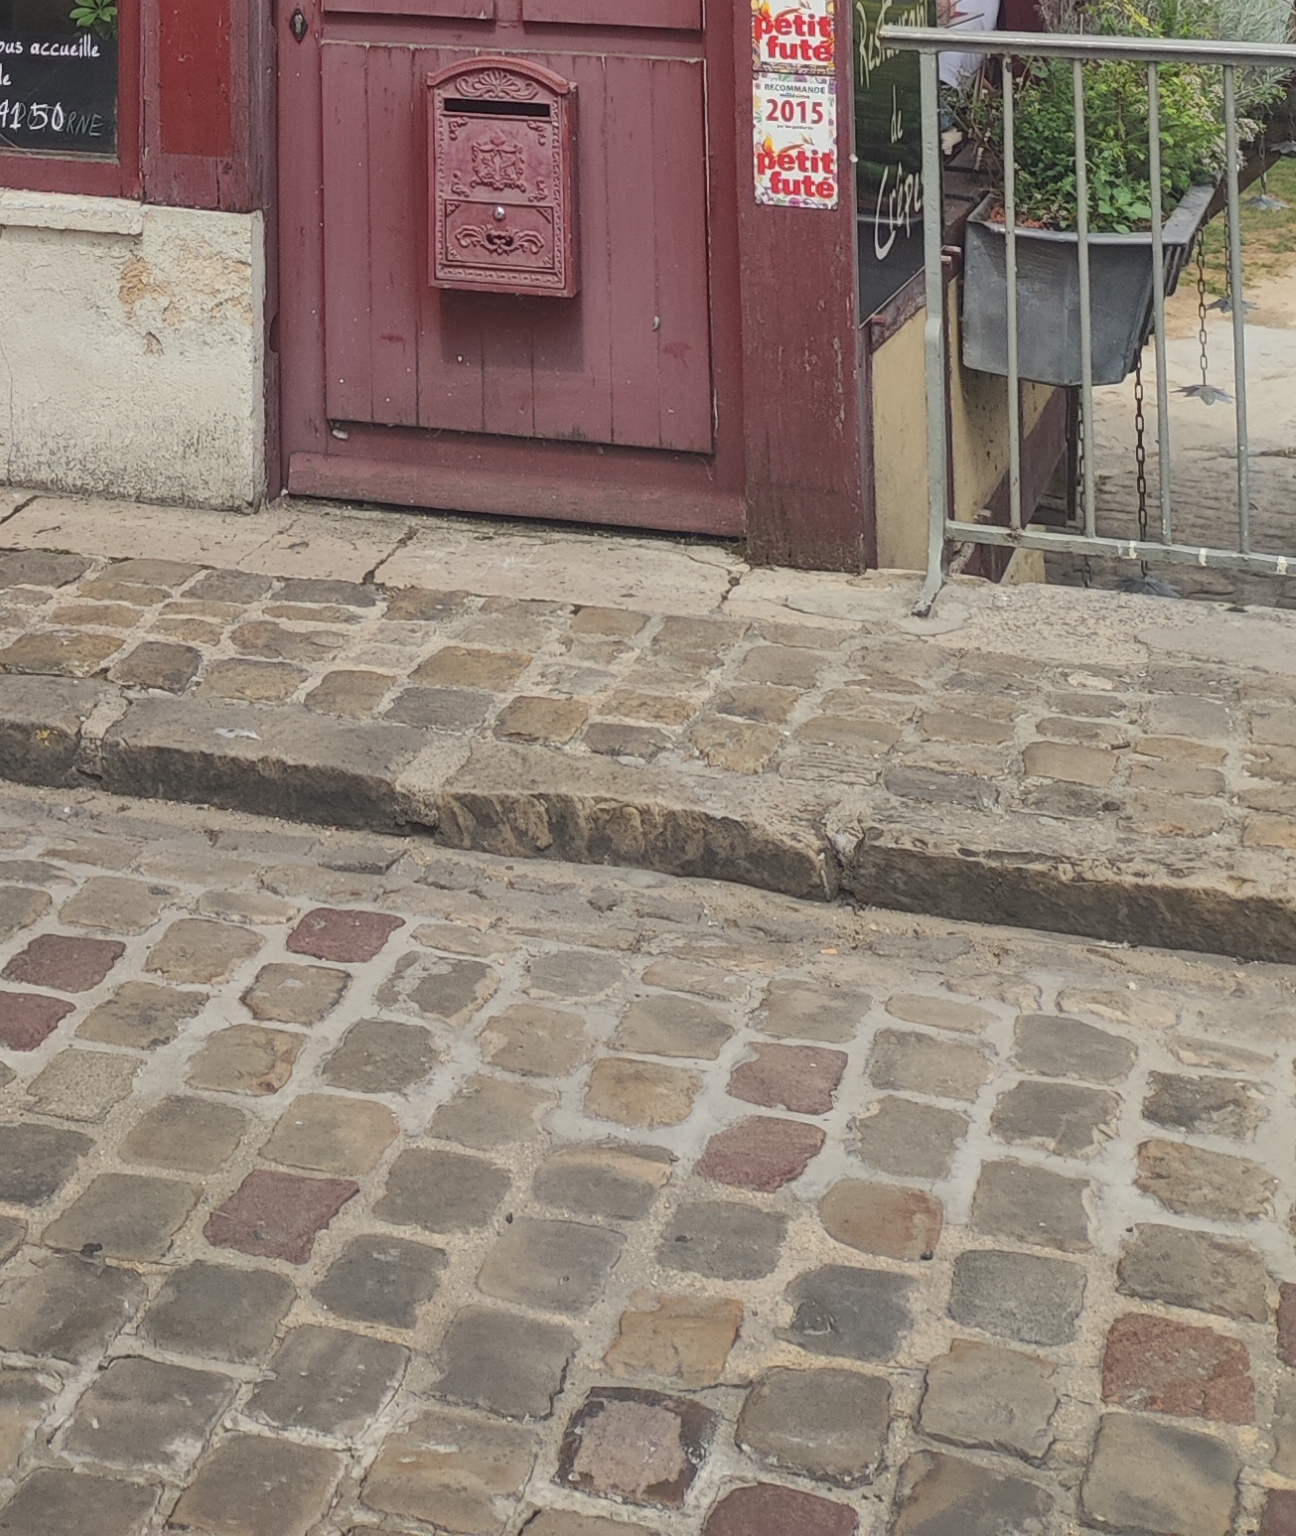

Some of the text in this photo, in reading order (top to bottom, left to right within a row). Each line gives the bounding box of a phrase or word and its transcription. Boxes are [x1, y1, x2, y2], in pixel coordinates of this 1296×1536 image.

[754, 13, 831, 41] petit
[30, 34, 101, 58] accueille
[766, 35, 832, 62] futé
[30, 102, 64, 131] 50
[765, 98, 823, 124] 2015
[890, 84, 903, 144] de
[757, 149, 834, 175] petit
[769, 171, 834, 199] futé
[875, 161, 923, 260] Crêpe
